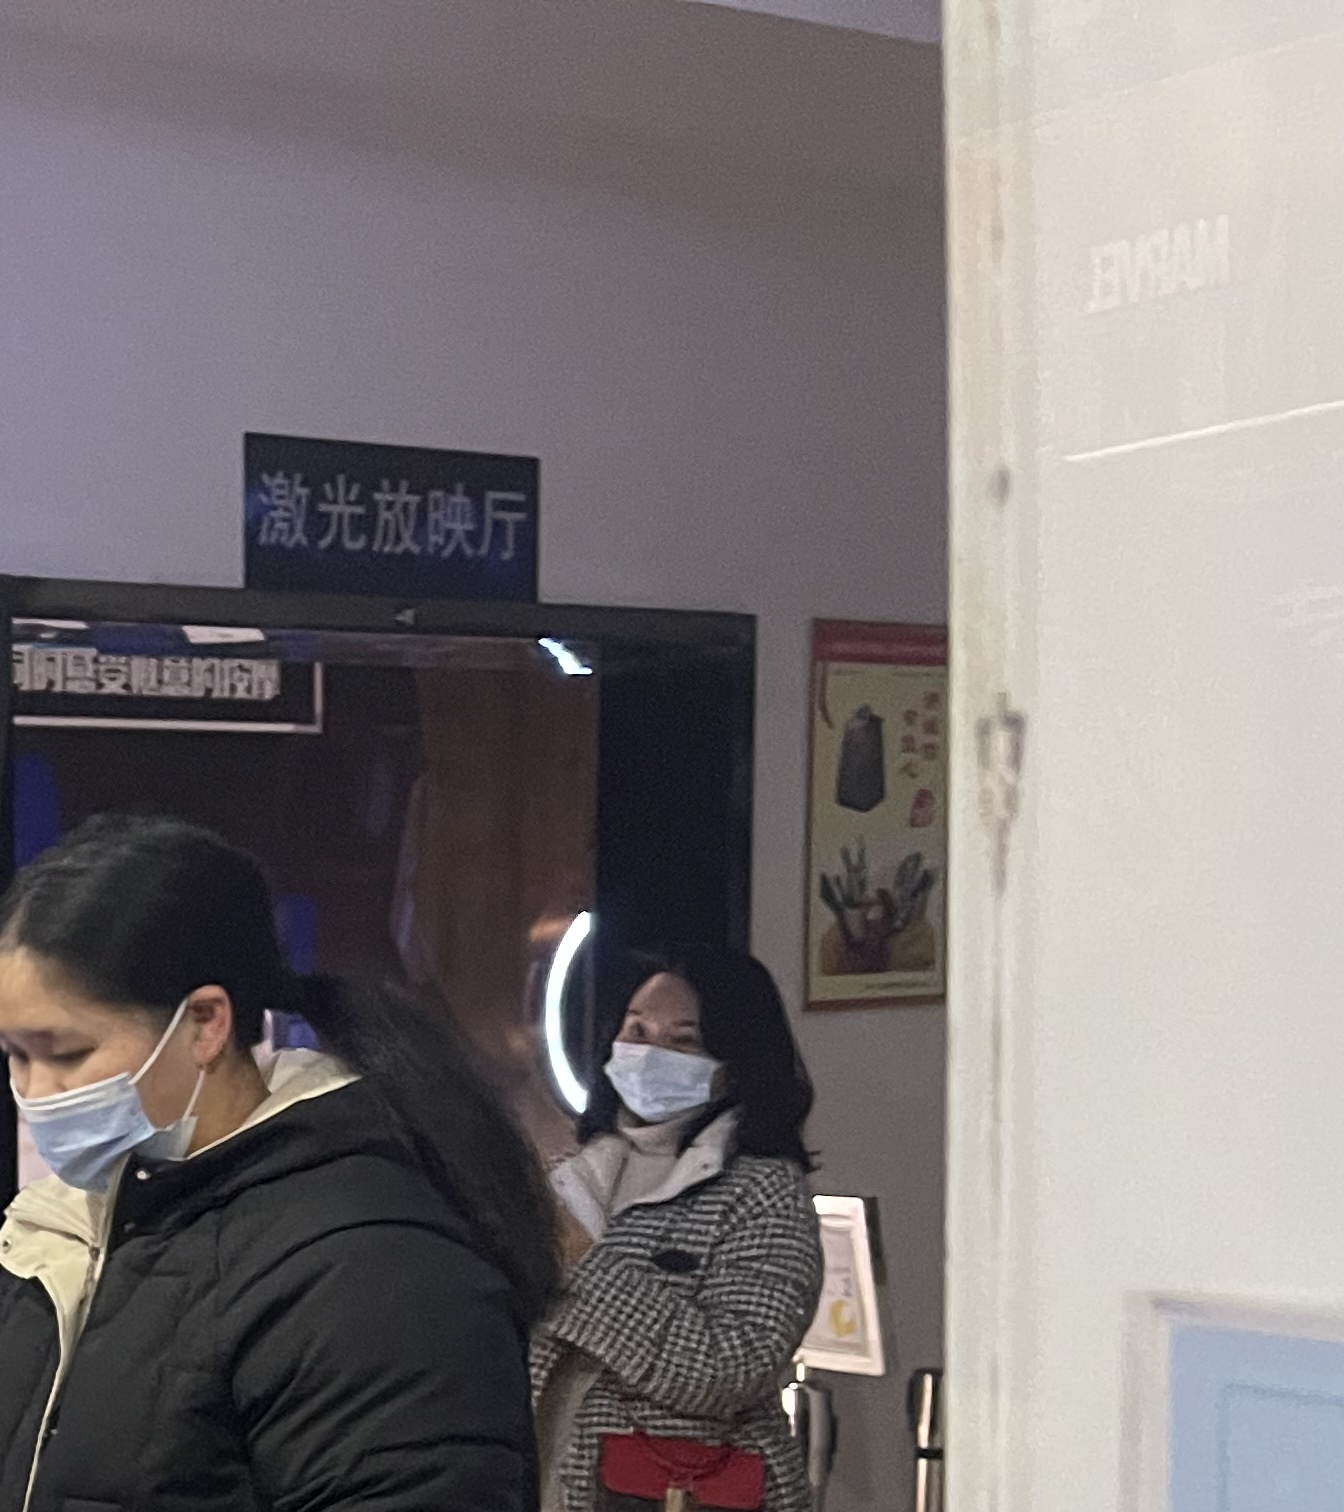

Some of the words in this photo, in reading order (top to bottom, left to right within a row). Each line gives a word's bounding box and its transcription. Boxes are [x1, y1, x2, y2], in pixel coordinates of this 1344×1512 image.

[258, 470, 528, 560] 激光放映厅
